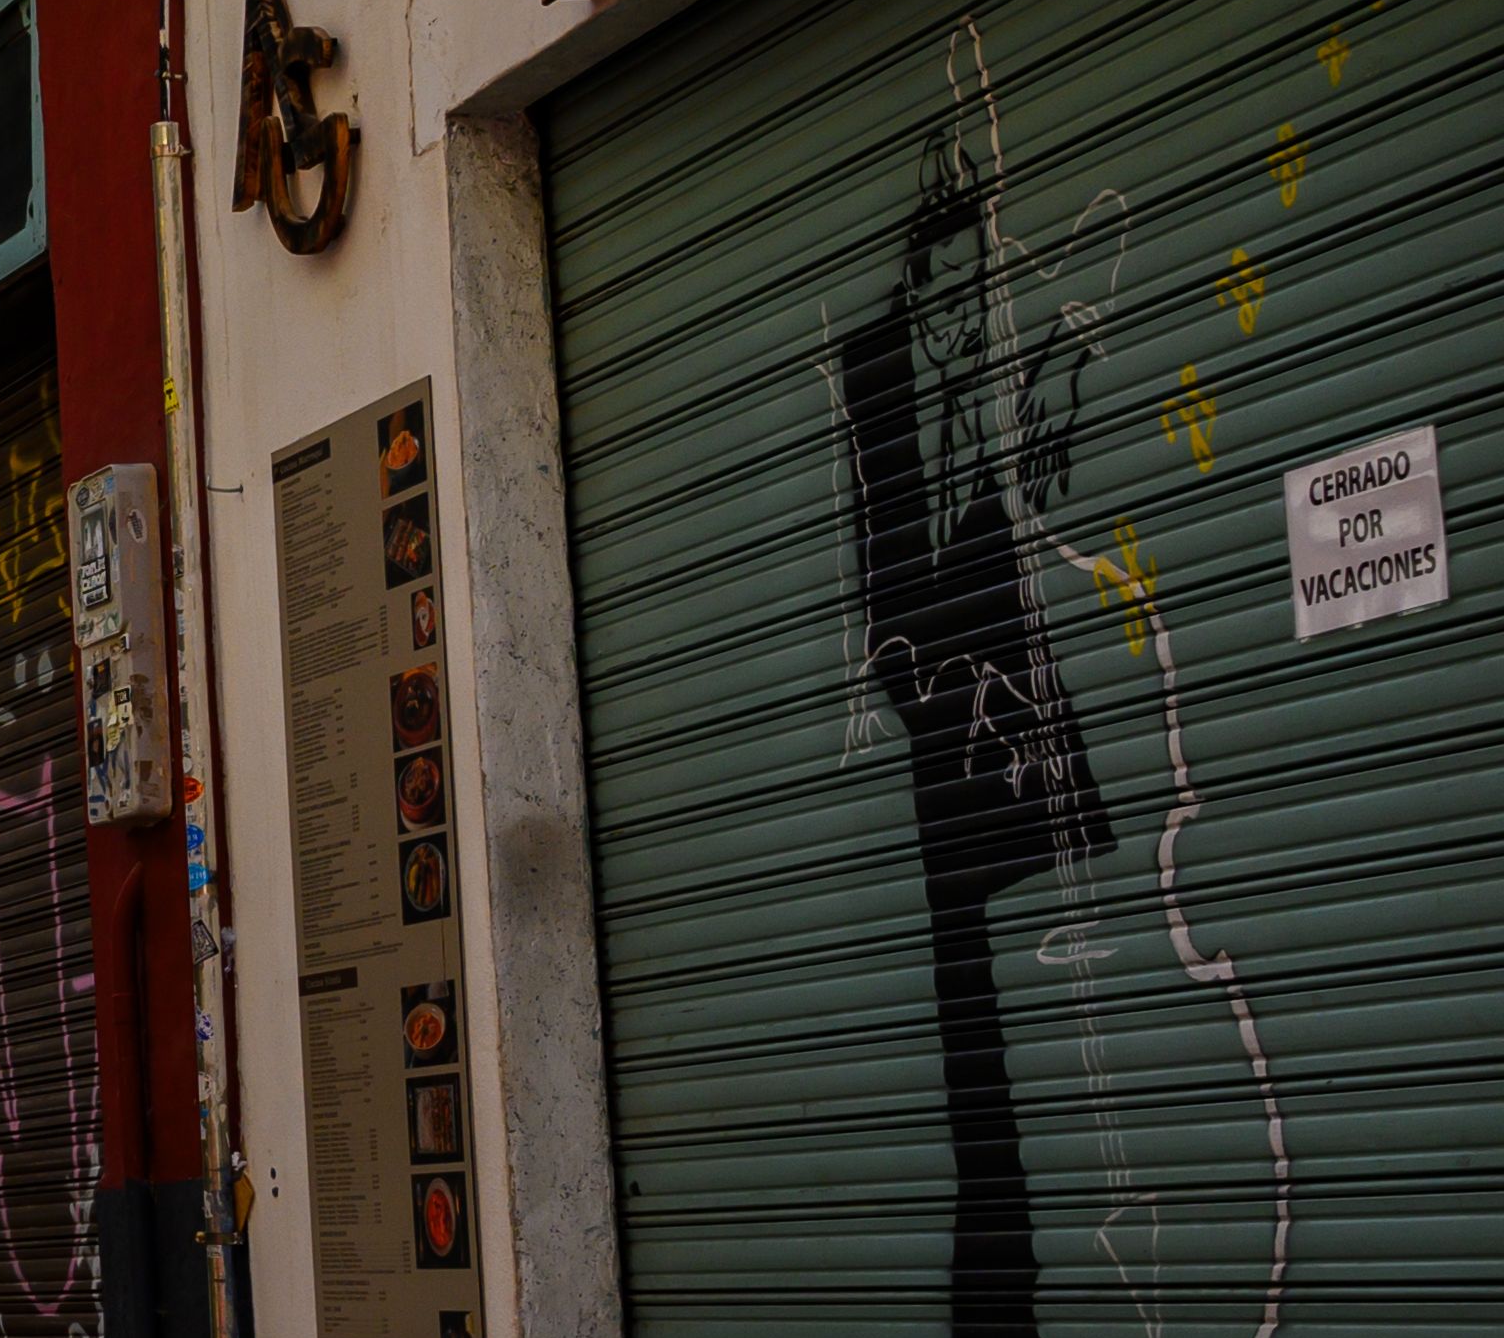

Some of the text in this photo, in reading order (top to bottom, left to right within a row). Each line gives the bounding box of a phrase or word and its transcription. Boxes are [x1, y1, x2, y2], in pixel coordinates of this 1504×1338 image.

[1309, 450, 1411, 507] CERRADO
[1338, 510, 1384, 547] POR
[1301, 543, 1437, 607] VACACIONES
